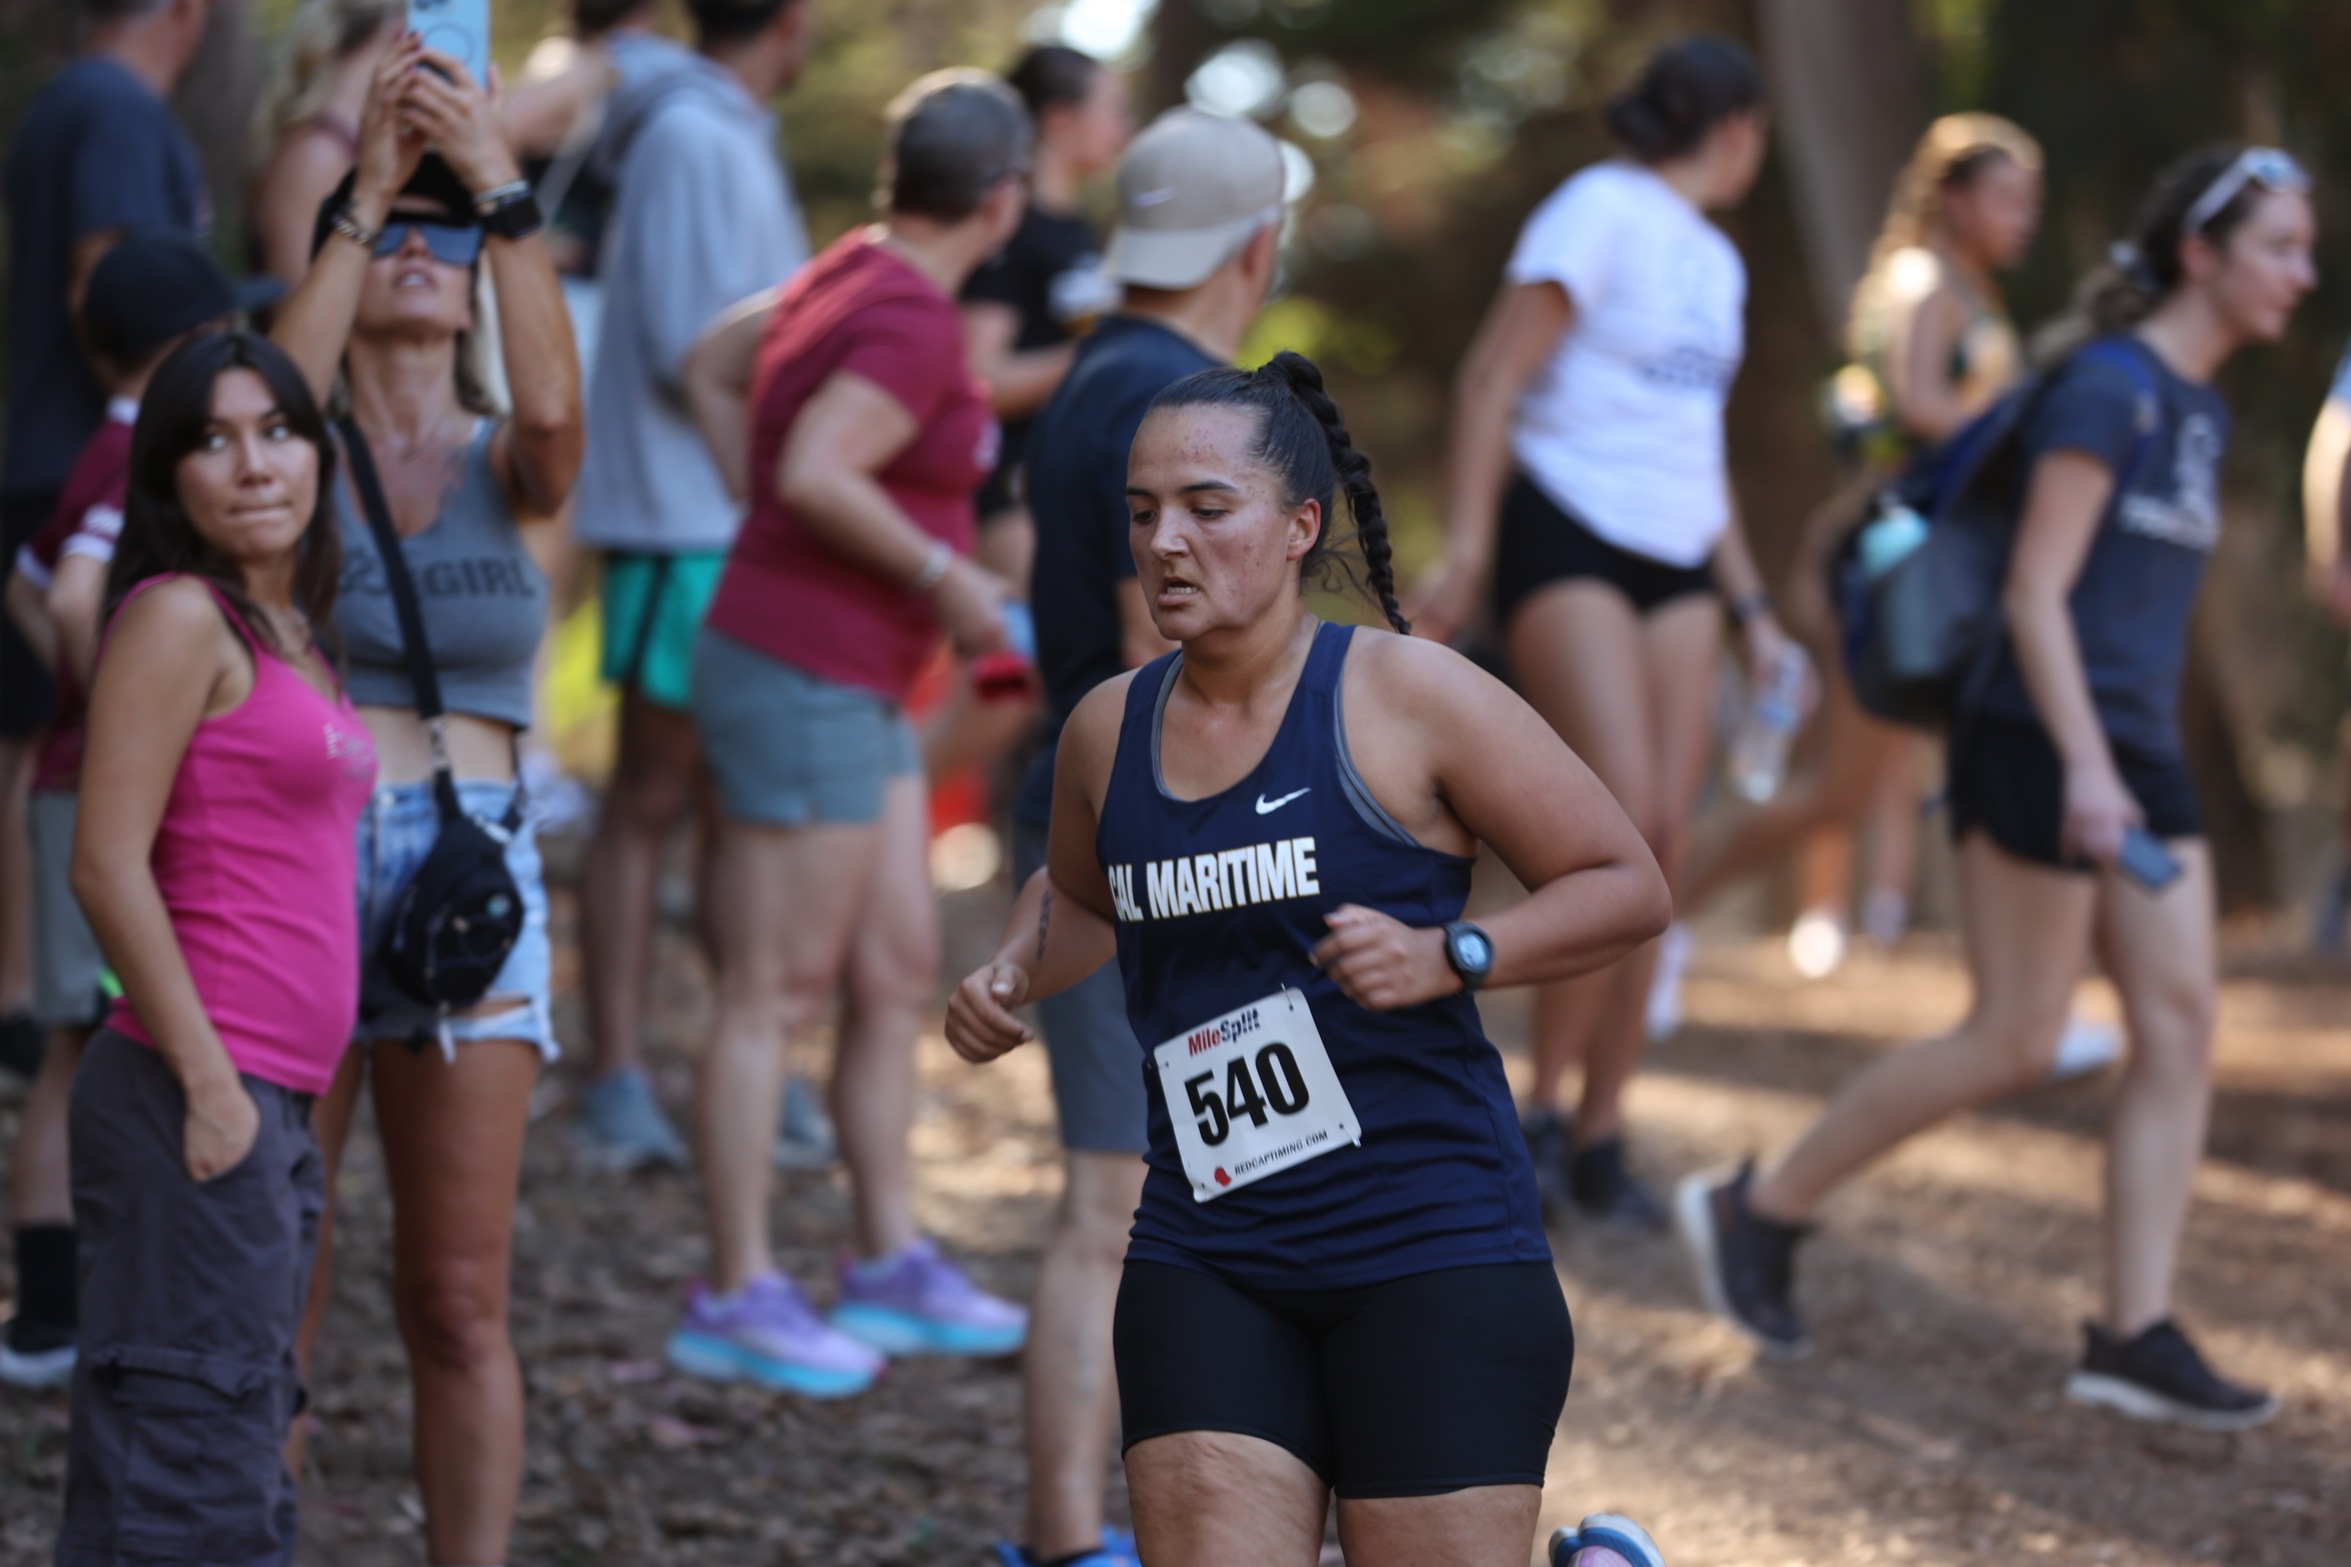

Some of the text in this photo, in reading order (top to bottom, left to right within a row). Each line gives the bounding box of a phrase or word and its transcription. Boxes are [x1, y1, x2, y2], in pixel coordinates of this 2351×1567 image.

[1146, 836, 1320, 920] MARITIME
[1187, 1007, 1261, 1057] MileSplit
[1184, 1041, 1310, 1147] 540
[1234, 1129, 1329, 1176] REDCAPTIMING.COM
